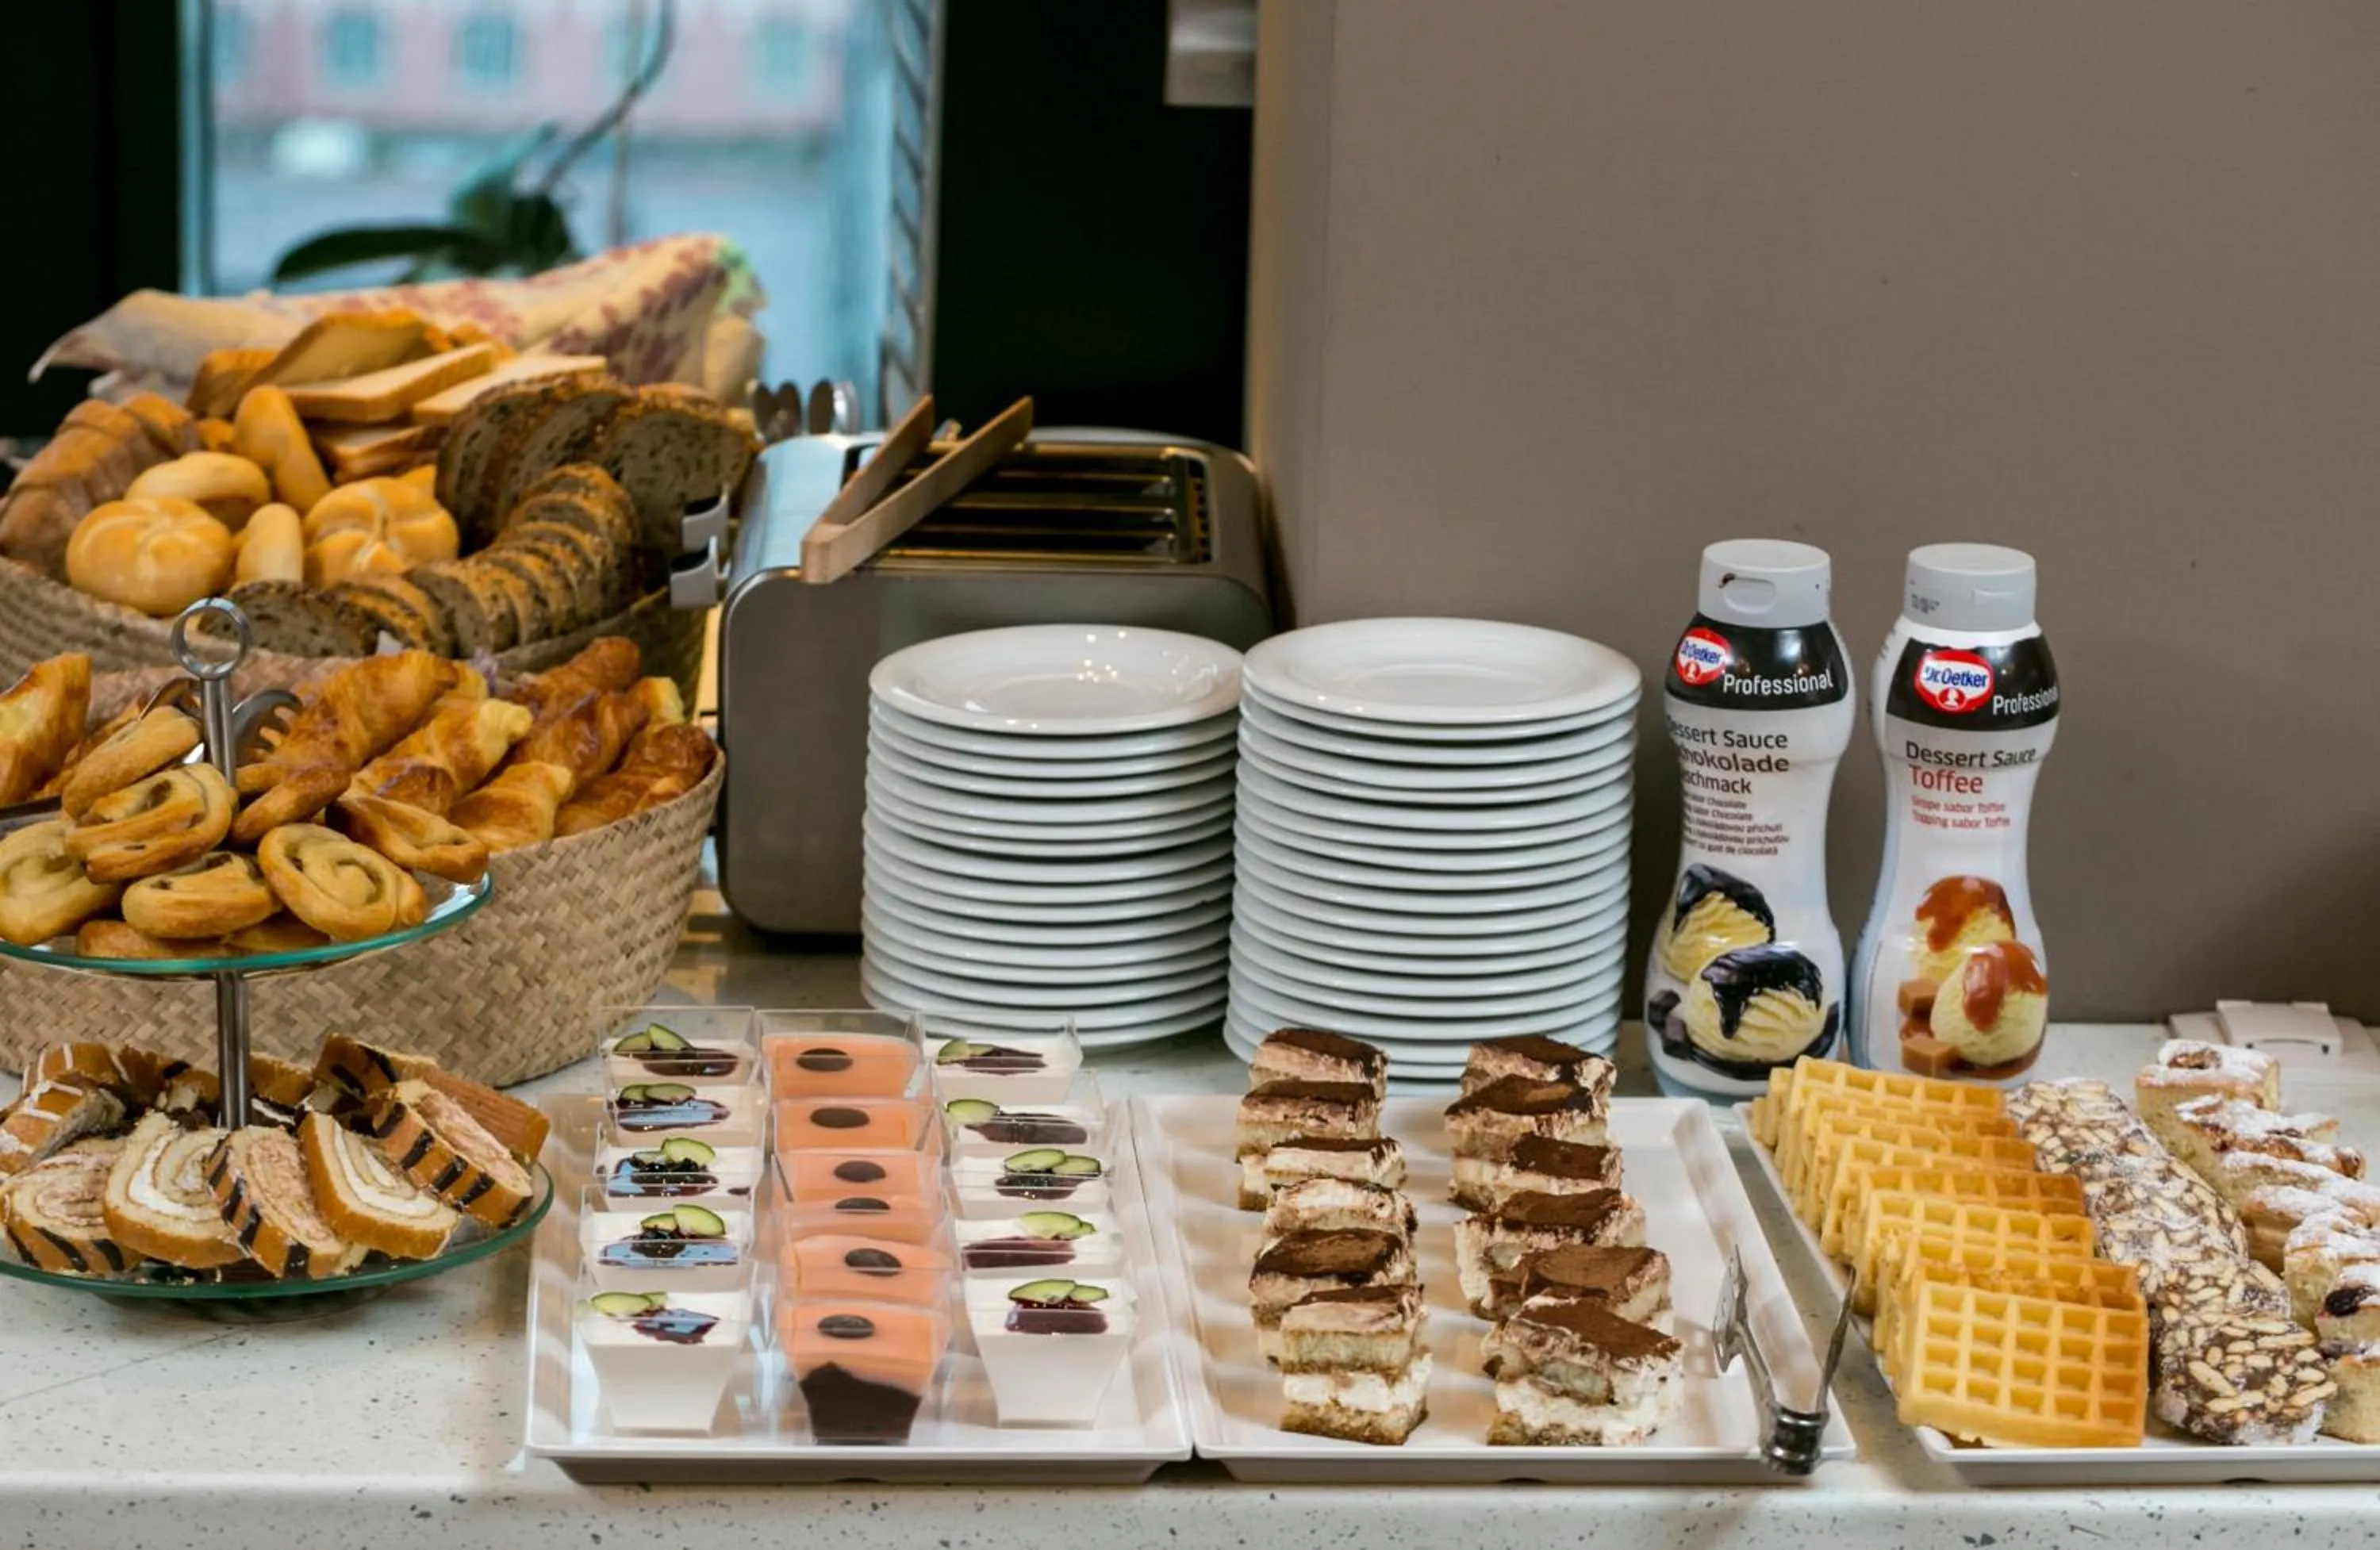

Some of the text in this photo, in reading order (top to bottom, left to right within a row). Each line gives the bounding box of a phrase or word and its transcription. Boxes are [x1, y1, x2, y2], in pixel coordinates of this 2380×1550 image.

[1722, 665, 1833, 695] Professional
[1992, 686, 2059, 716] Professiona
[1723, 729, 1788, 749] Sauce
[1906, 740, 2036, 768] Dessert Sauce
[1908, 763, 1983, 793] Toffee
